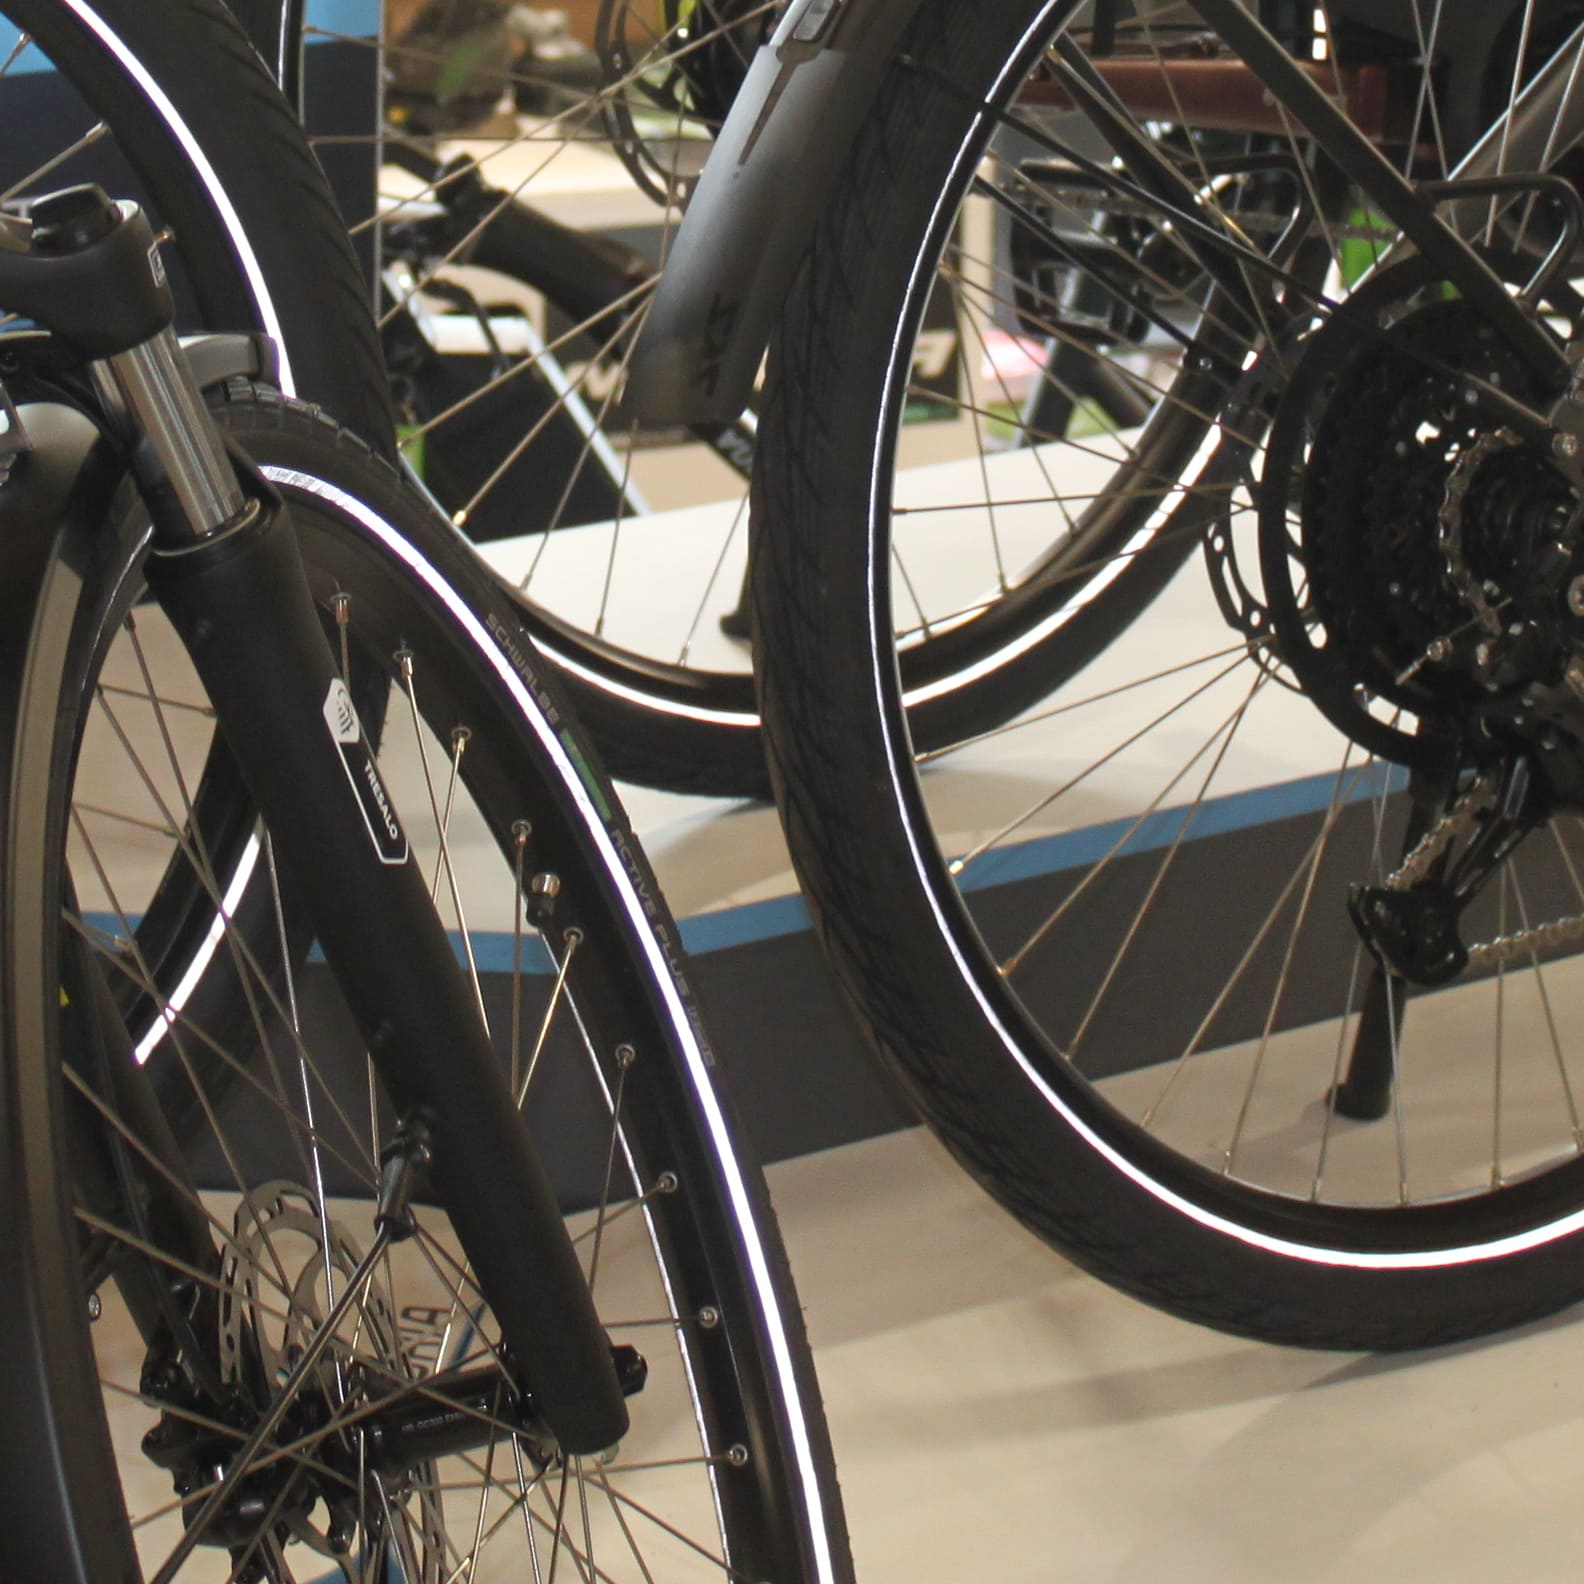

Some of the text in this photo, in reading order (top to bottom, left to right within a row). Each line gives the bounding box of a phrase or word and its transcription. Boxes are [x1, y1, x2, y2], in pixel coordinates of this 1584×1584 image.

[484, 613, 560, 724] SCHWALBE
[365, 759, 399, 841] TRESALO
[611, 828, 657, 916] ACTIVE
